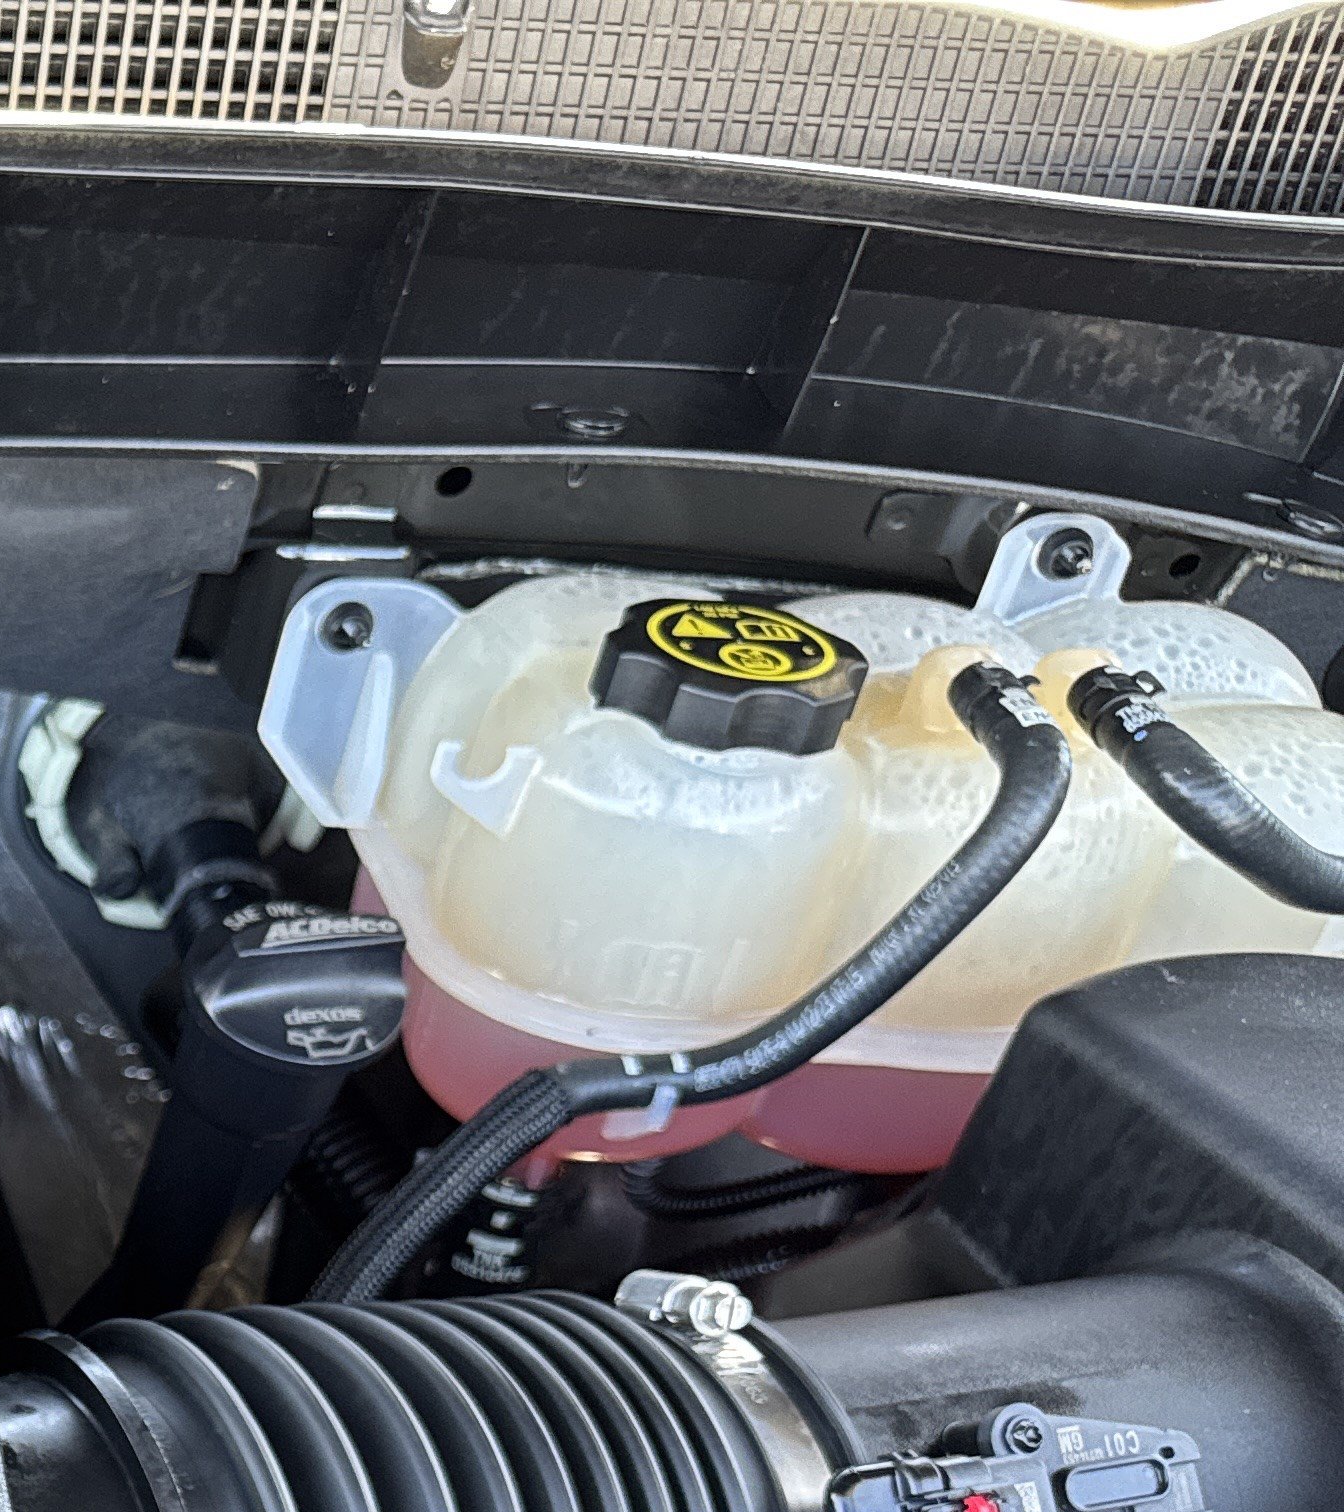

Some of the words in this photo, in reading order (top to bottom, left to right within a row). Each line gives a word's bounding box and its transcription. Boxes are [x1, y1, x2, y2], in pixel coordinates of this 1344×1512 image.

[223, 903, 262, 932] SAE
[265, 915, 398, 944] ACDelco
[284, 1005, 365, 1026] dexos
[1057, 1426, 1085, 1454] GM
